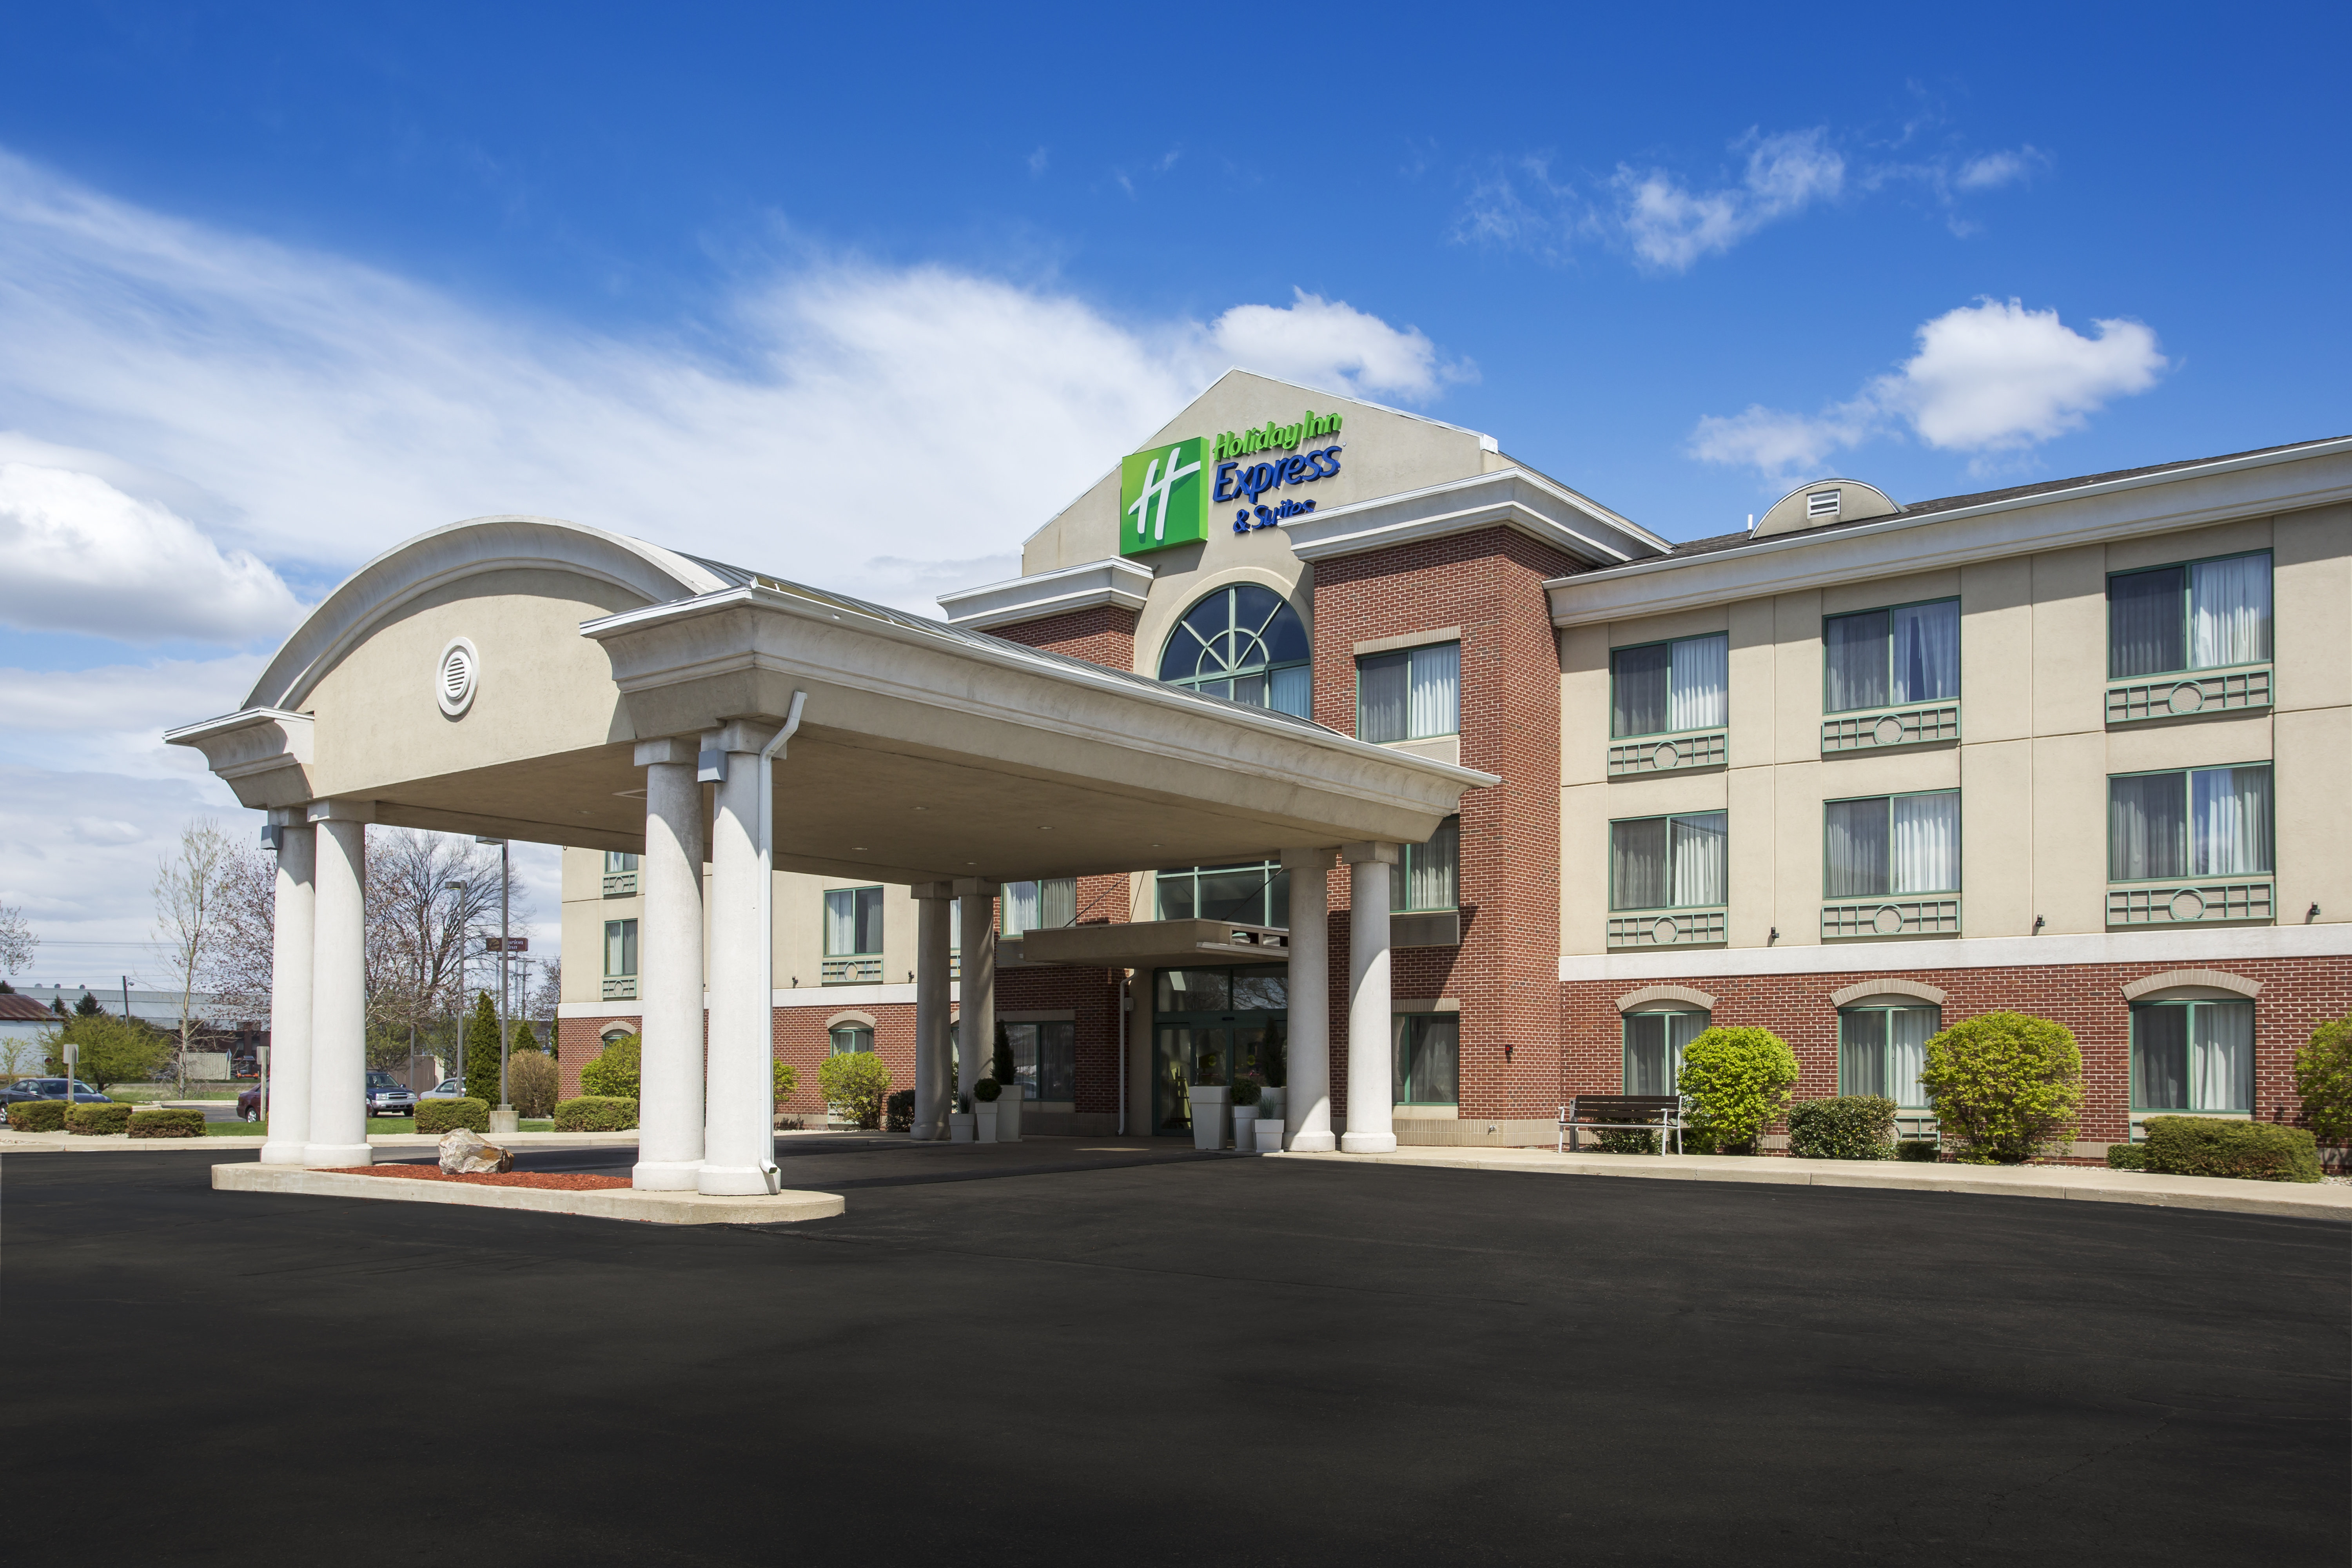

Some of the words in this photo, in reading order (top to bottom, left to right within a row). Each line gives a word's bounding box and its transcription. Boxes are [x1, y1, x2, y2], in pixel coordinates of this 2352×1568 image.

[1212, 421, 1303, 462] Holiday
[1302, 410, 1343, 439] Inn
[1212, 446, 1342, 505] Express
[1233, 509, 1250, 534] &
